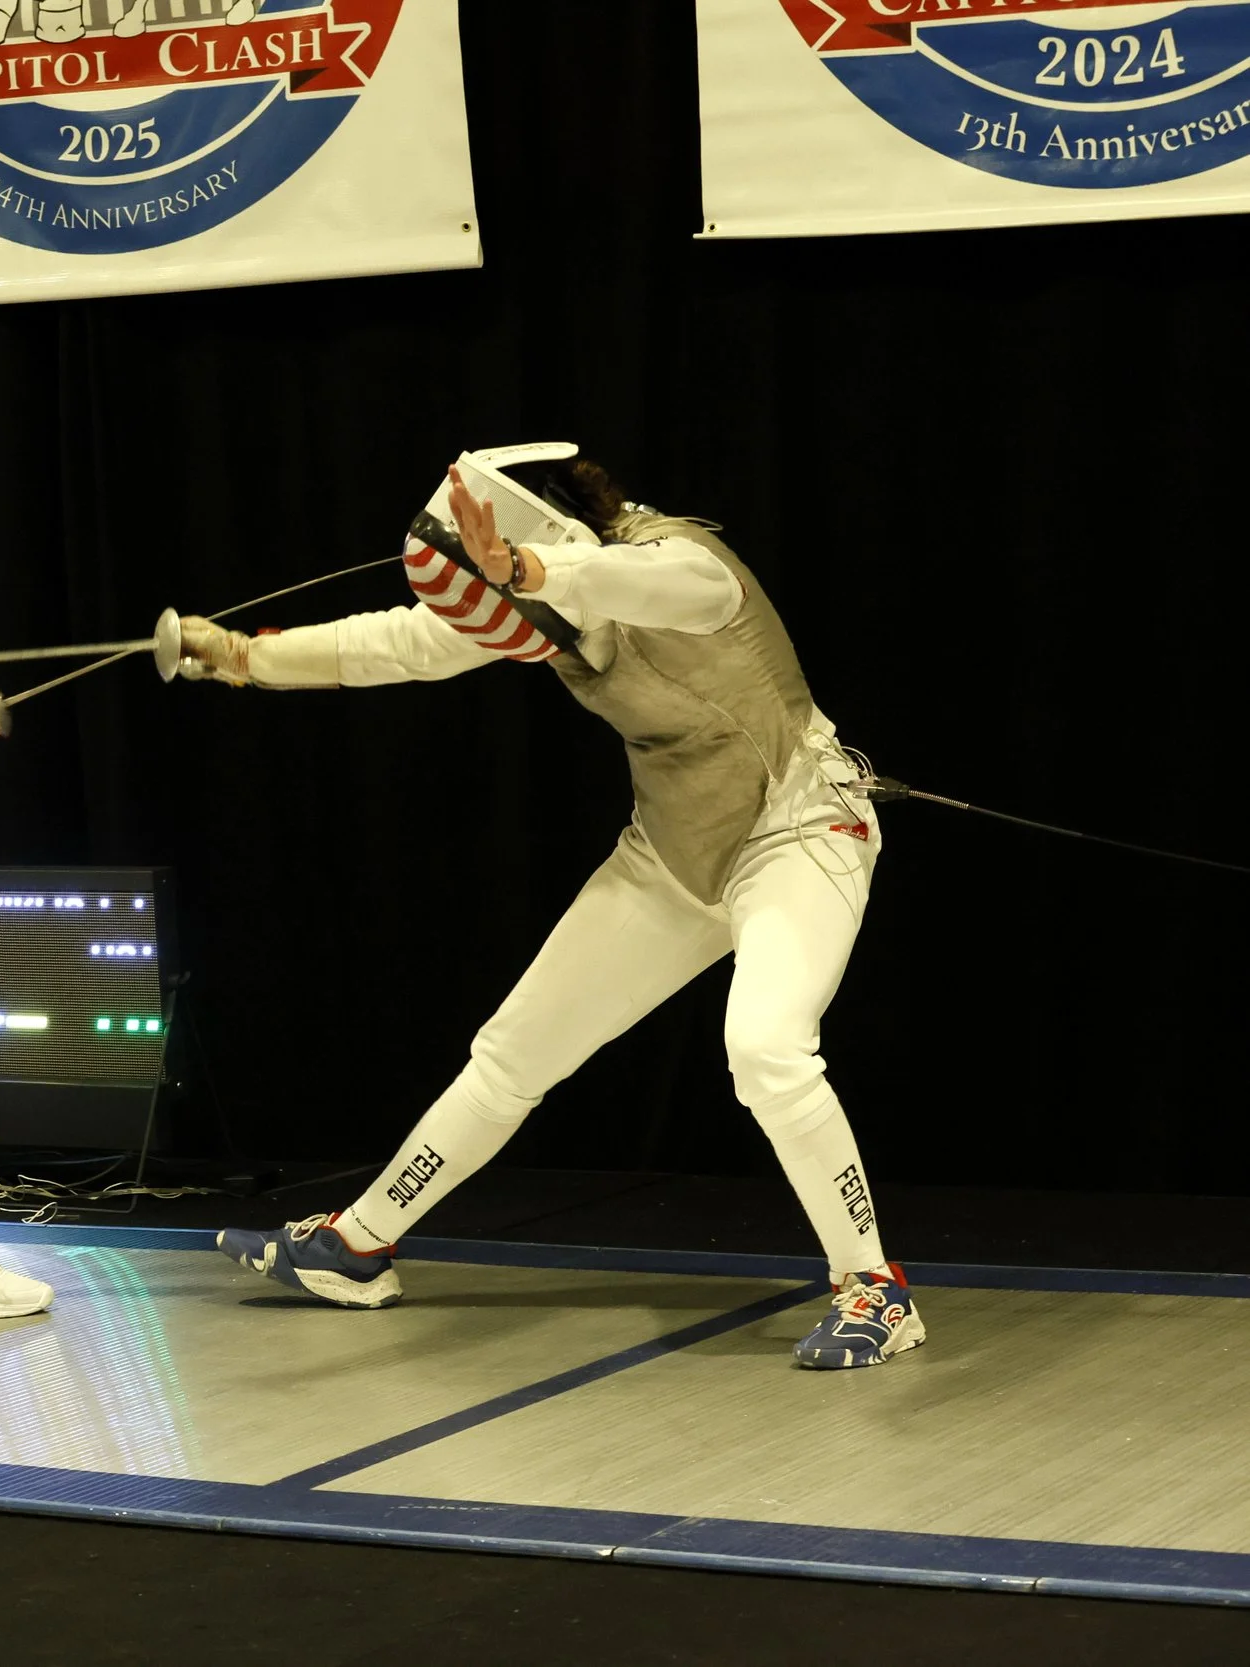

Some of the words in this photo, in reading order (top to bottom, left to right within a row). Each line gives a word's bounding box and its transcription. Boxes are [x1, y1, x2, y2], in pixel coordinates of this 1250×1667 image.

[159, 28, 324, 76] CLASH
[1035, 28, 1185, 87] 2024
[58, 117, 161, 162] 2025
[955, 111, 1027, 153] 13th
[1039, 99, 1250, 160] Anniversar
[52, 160, 239, 230] ANNIVERSARY
[387, 1144, 445, 1208] FENCING
[834, 1164, 874, 1235] FENCING
